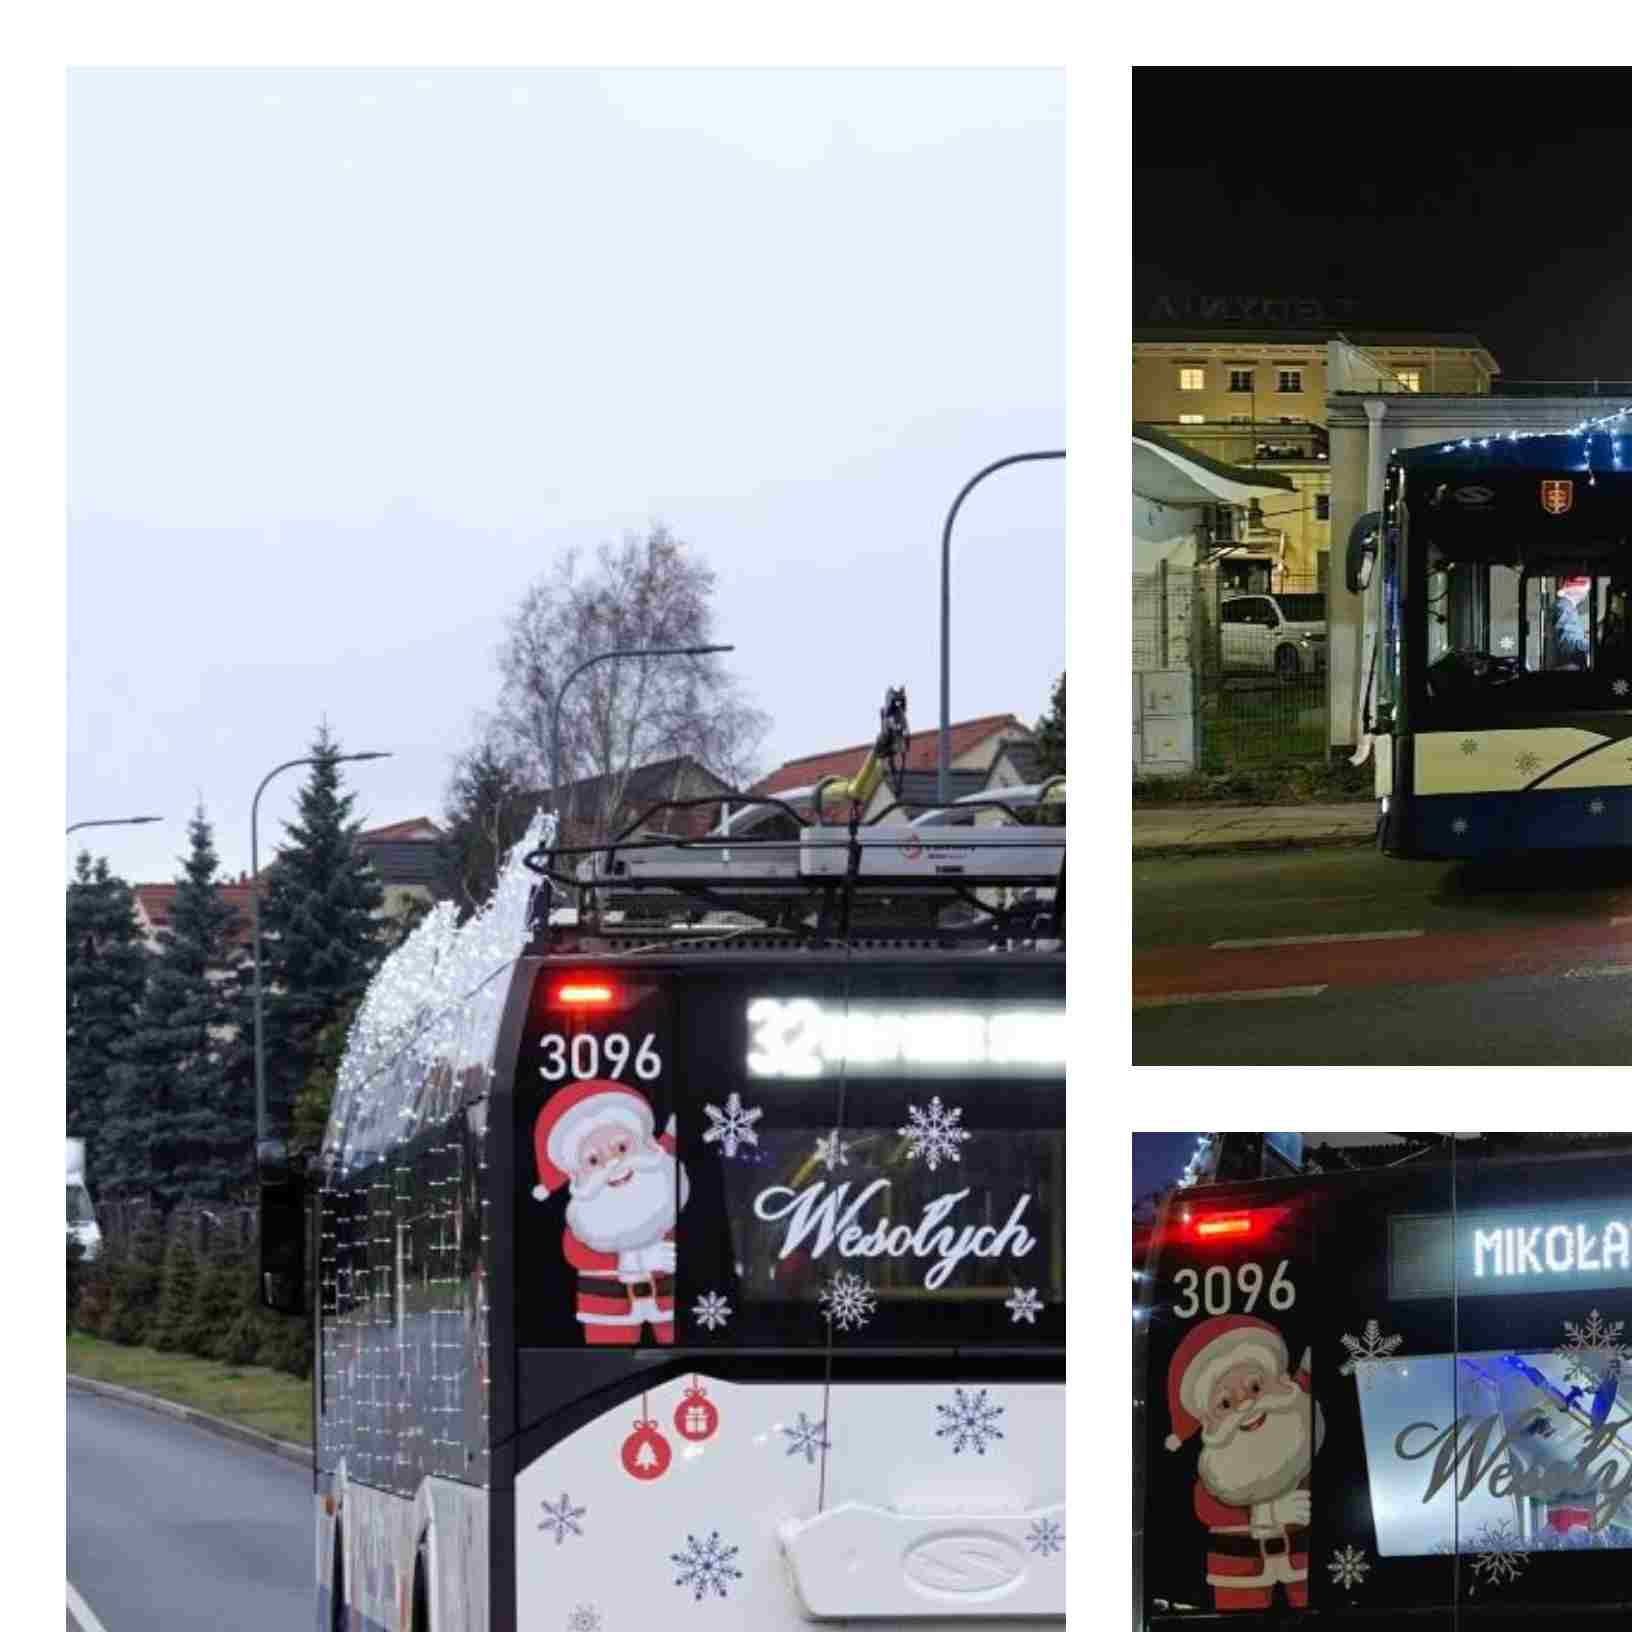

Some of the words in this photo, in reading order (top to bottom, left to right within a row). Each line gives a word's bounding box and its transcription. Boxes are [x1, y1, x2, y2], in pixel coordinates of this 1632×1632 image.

[539, 1033, 661, 1080] 3096
[747, 998, 822, 1077] 32
[753, 1178, 1036, 1290] Wesołych
[1173, 1259, 1296, 1319] 3096
